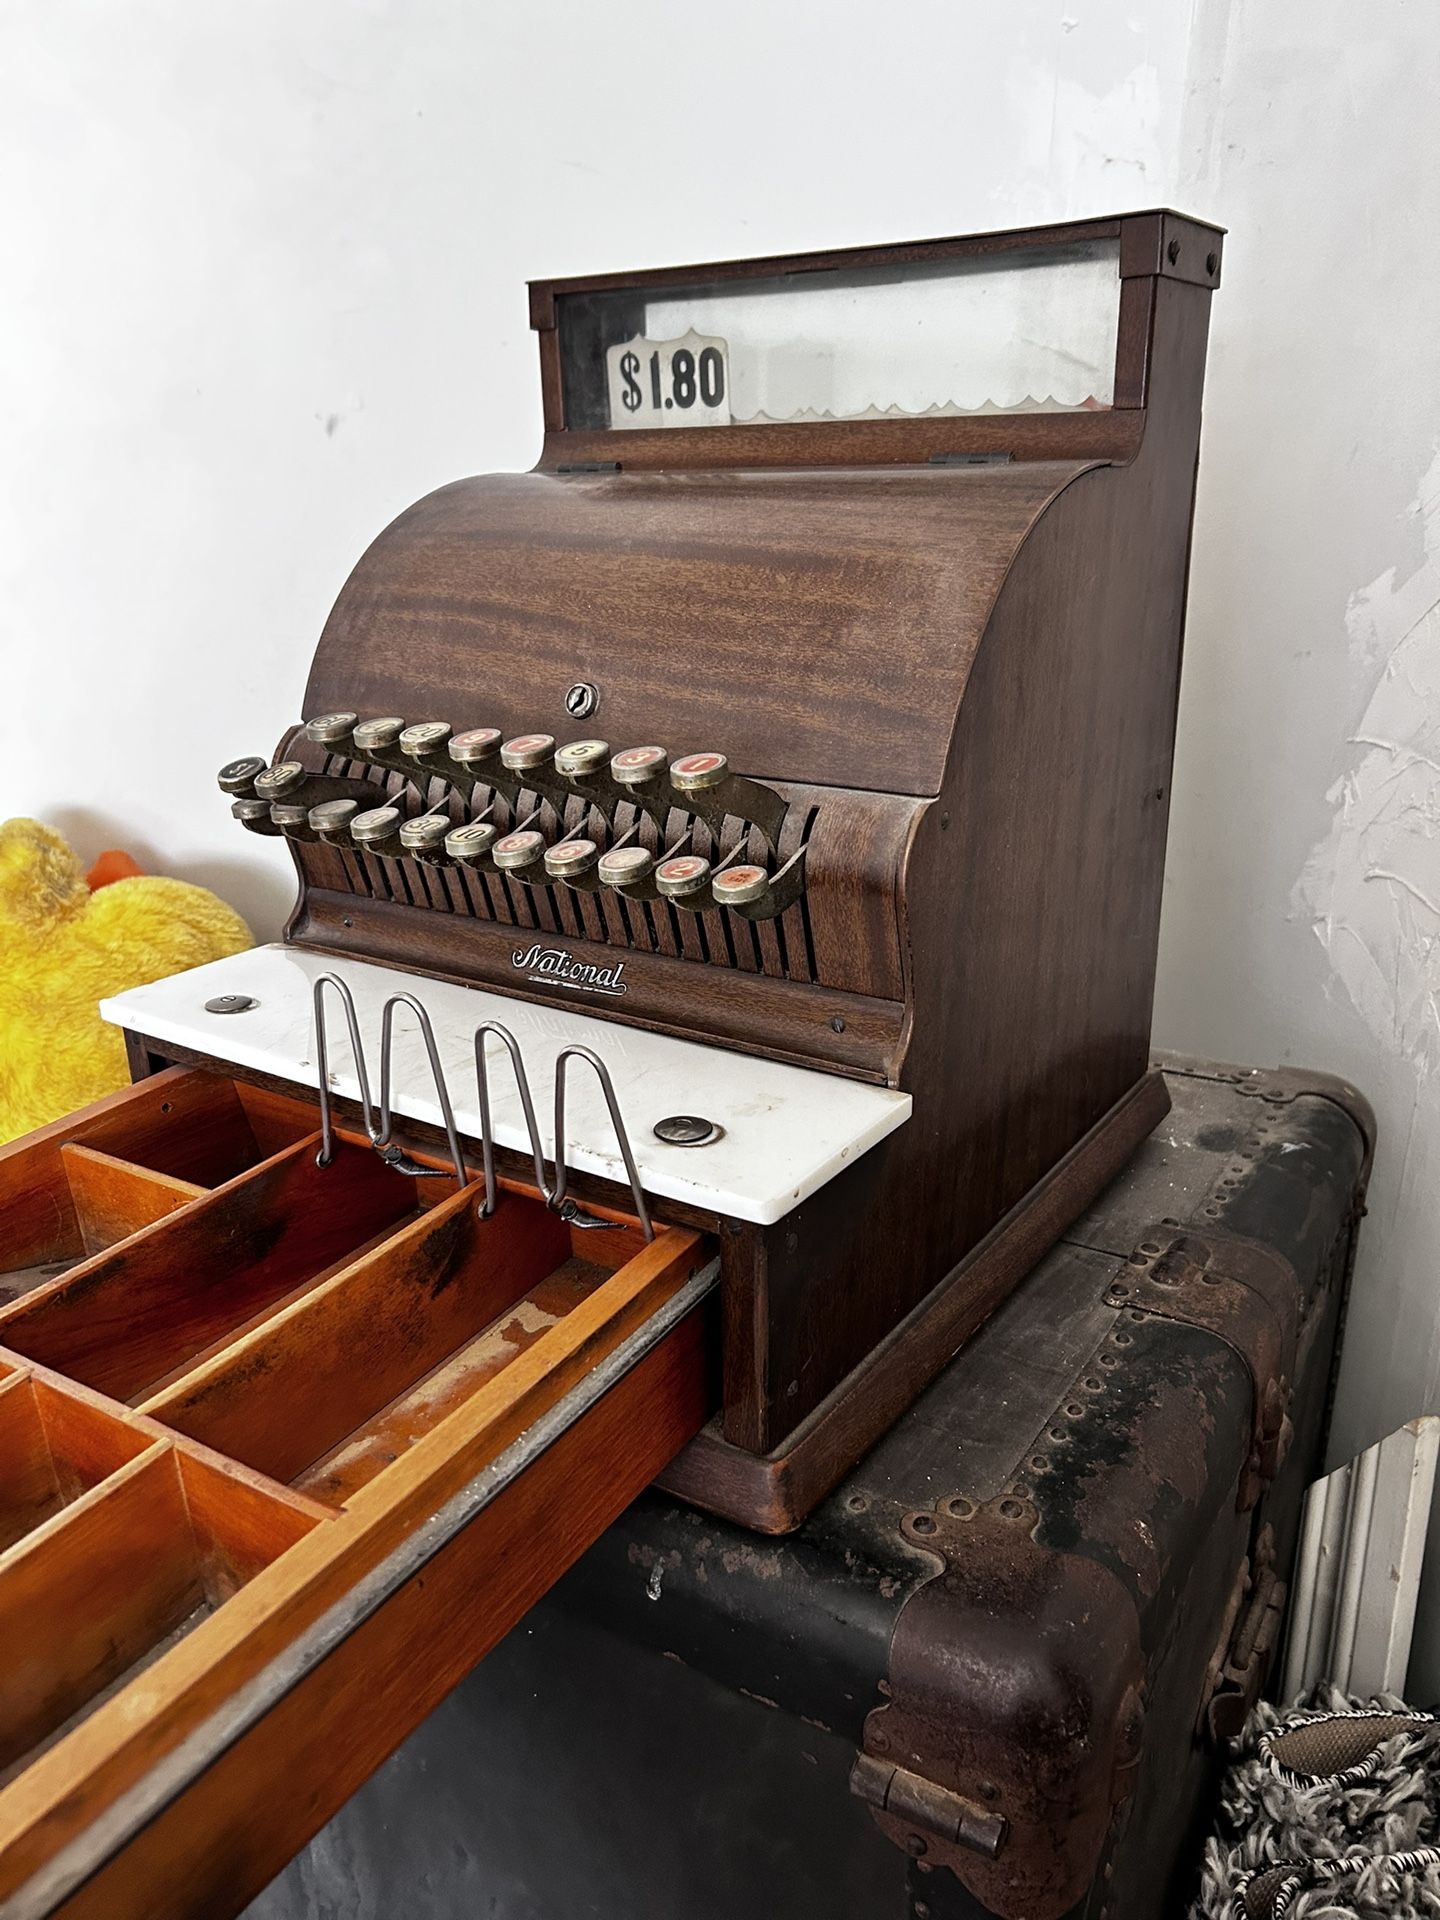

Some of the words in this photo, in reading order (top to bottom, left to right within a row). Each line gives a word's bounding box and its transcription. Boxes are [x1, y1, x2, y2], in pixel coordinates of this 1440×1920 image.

[620, 346, 725, 413] $1.80
[408, 726, 443, 738] 20
[571, 745, 594, 755] 5
[626, 752, 651, 764] 3
[262, 767, 294, 781] 80
[408, 819, 442, 831] 30
[456, 827, 487, 839] 10
[669, 862, 696, 876] 2
[512, 944, 627, 995] National
